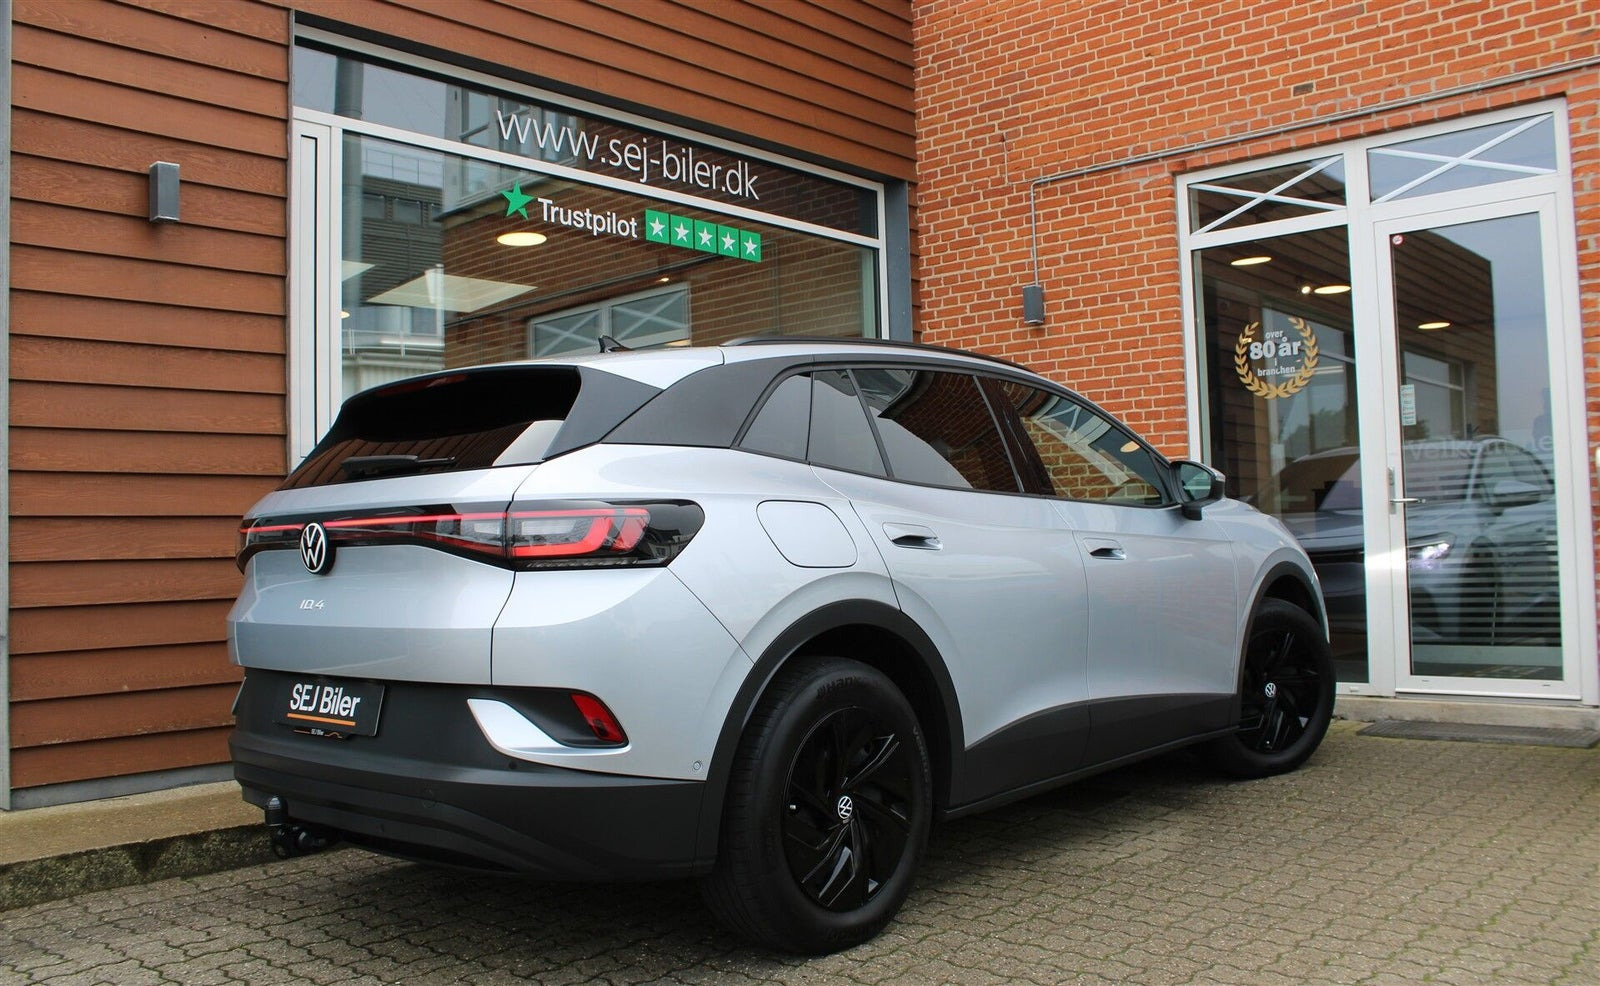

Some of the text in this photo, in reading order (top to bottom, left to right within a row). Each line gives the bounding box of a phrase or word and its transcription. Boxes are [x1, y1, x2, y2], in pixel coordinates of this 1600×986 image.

[496, 110, 760, 200] www.sej-biler.dk
[537, 197, 638, 238] Trustpilot
[1250, 336, 1301, 359] 80 år
[1265, 330, 1284, 339] over
[1258, 366, 1295, 377] branchen
[290, 683, 361, 717] SEJ Biler
